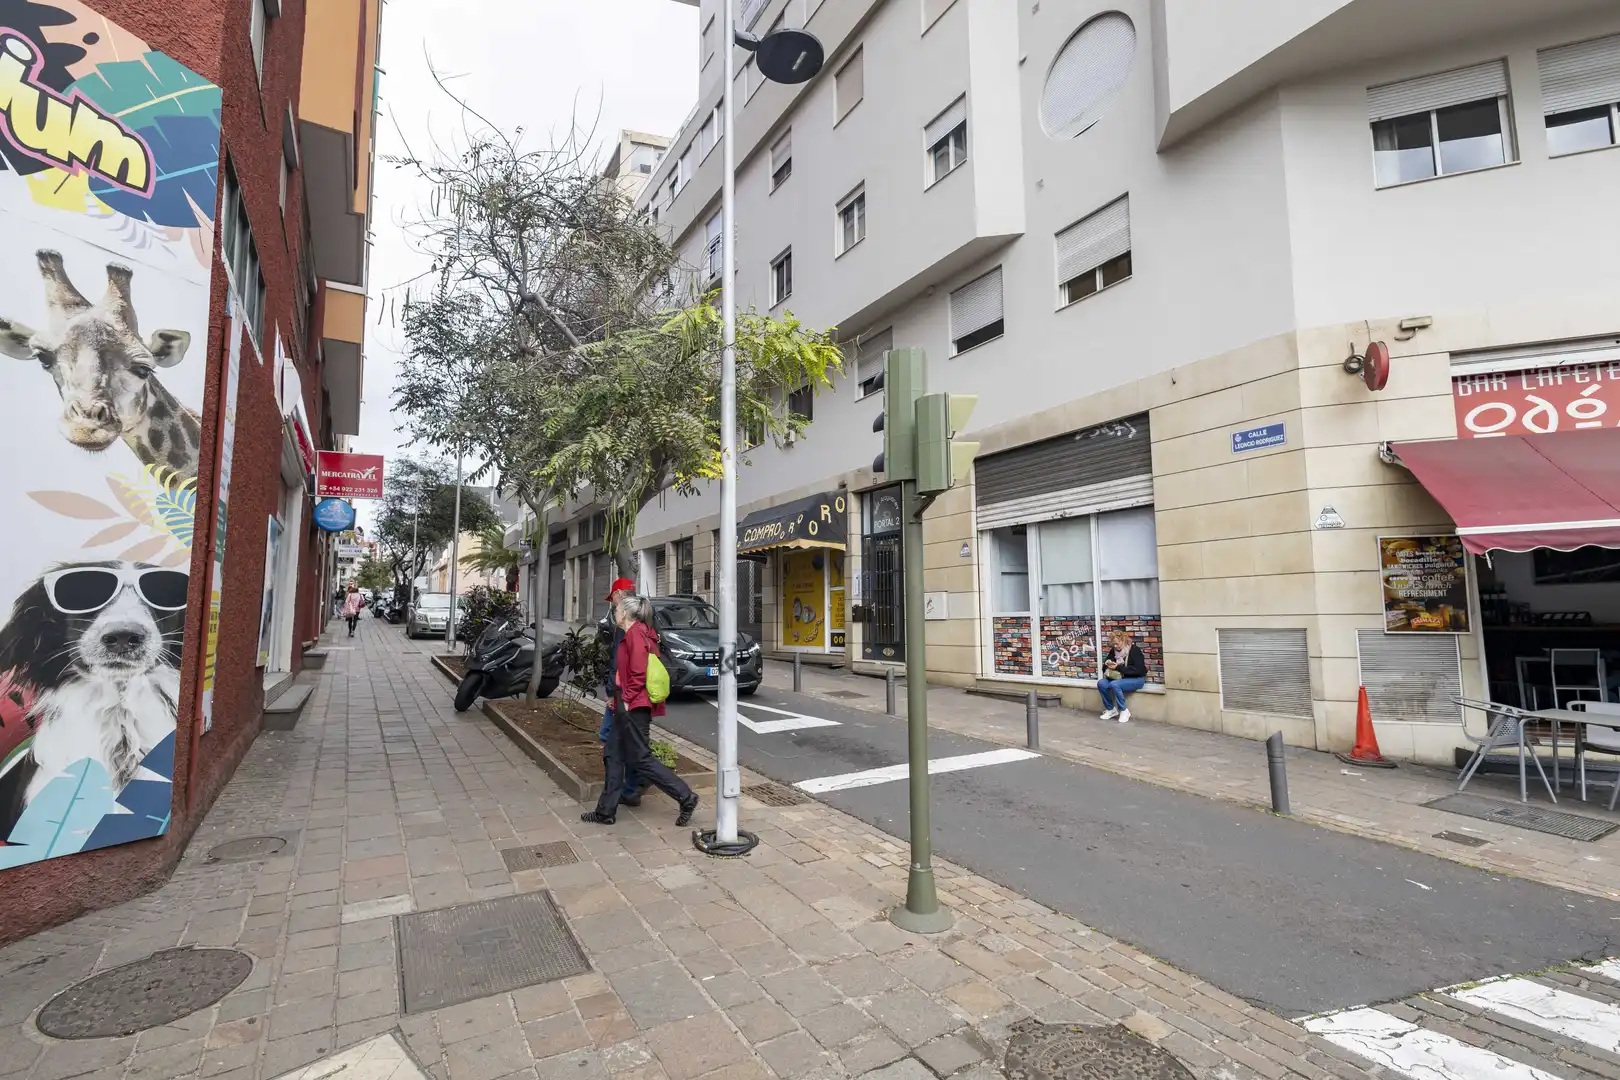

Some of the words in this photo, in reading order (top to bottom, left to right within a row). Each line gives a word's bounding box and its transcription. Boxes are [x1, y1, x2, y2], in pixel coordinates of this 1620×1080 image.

[1457, 372, 1508, 397] BAR
[1248, 429, 1267, 438] CALLE
[1235, 440, 1256, 450] LEONCIO
[321, 468, 376, 480] MERCATRAVEL
[874, 518, 895, 529] PORTAL
[895, 516, 900, 525] 2
[744, 522, 782, 543] COMPRO
[1422, 573, 1455, 582] coffee
